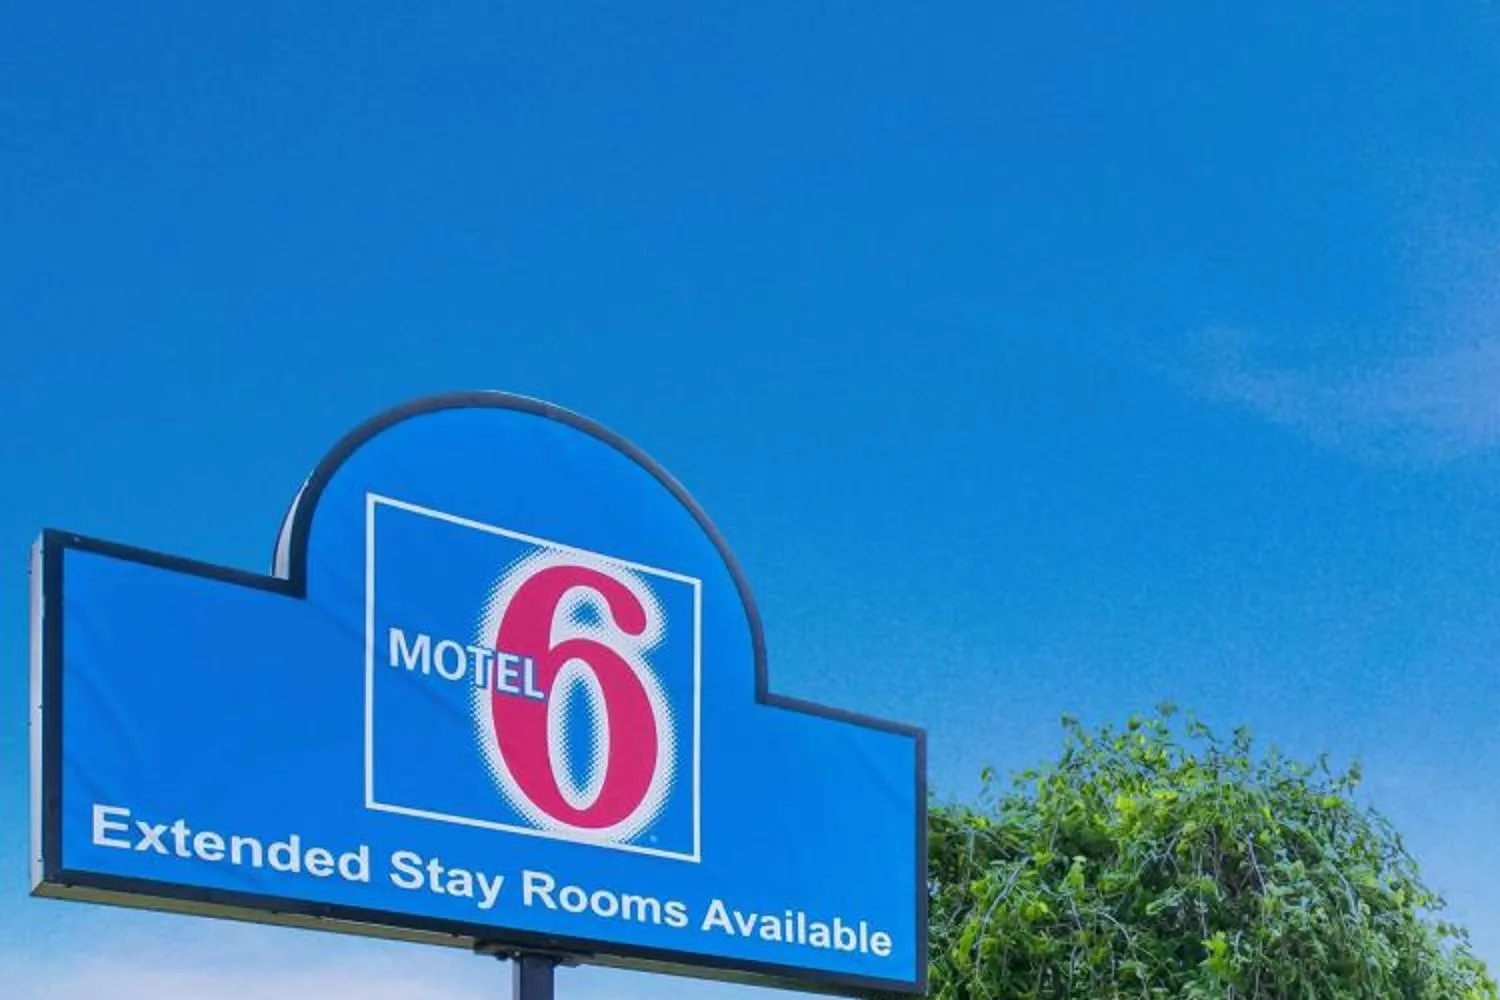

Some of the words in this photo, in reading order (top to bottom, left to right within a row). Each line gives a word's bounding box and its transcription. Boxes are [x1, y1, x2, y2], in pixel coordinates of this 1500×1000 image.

[388, 627, 545, 700] MOTEL
[488, 560, 660, 831] 6
[92, 803, 370, 884] Extended
[390, 851, 505, 909] Stay
[522, 870, 689, 928] Rooms
[702, 898, 892, 957] Available
